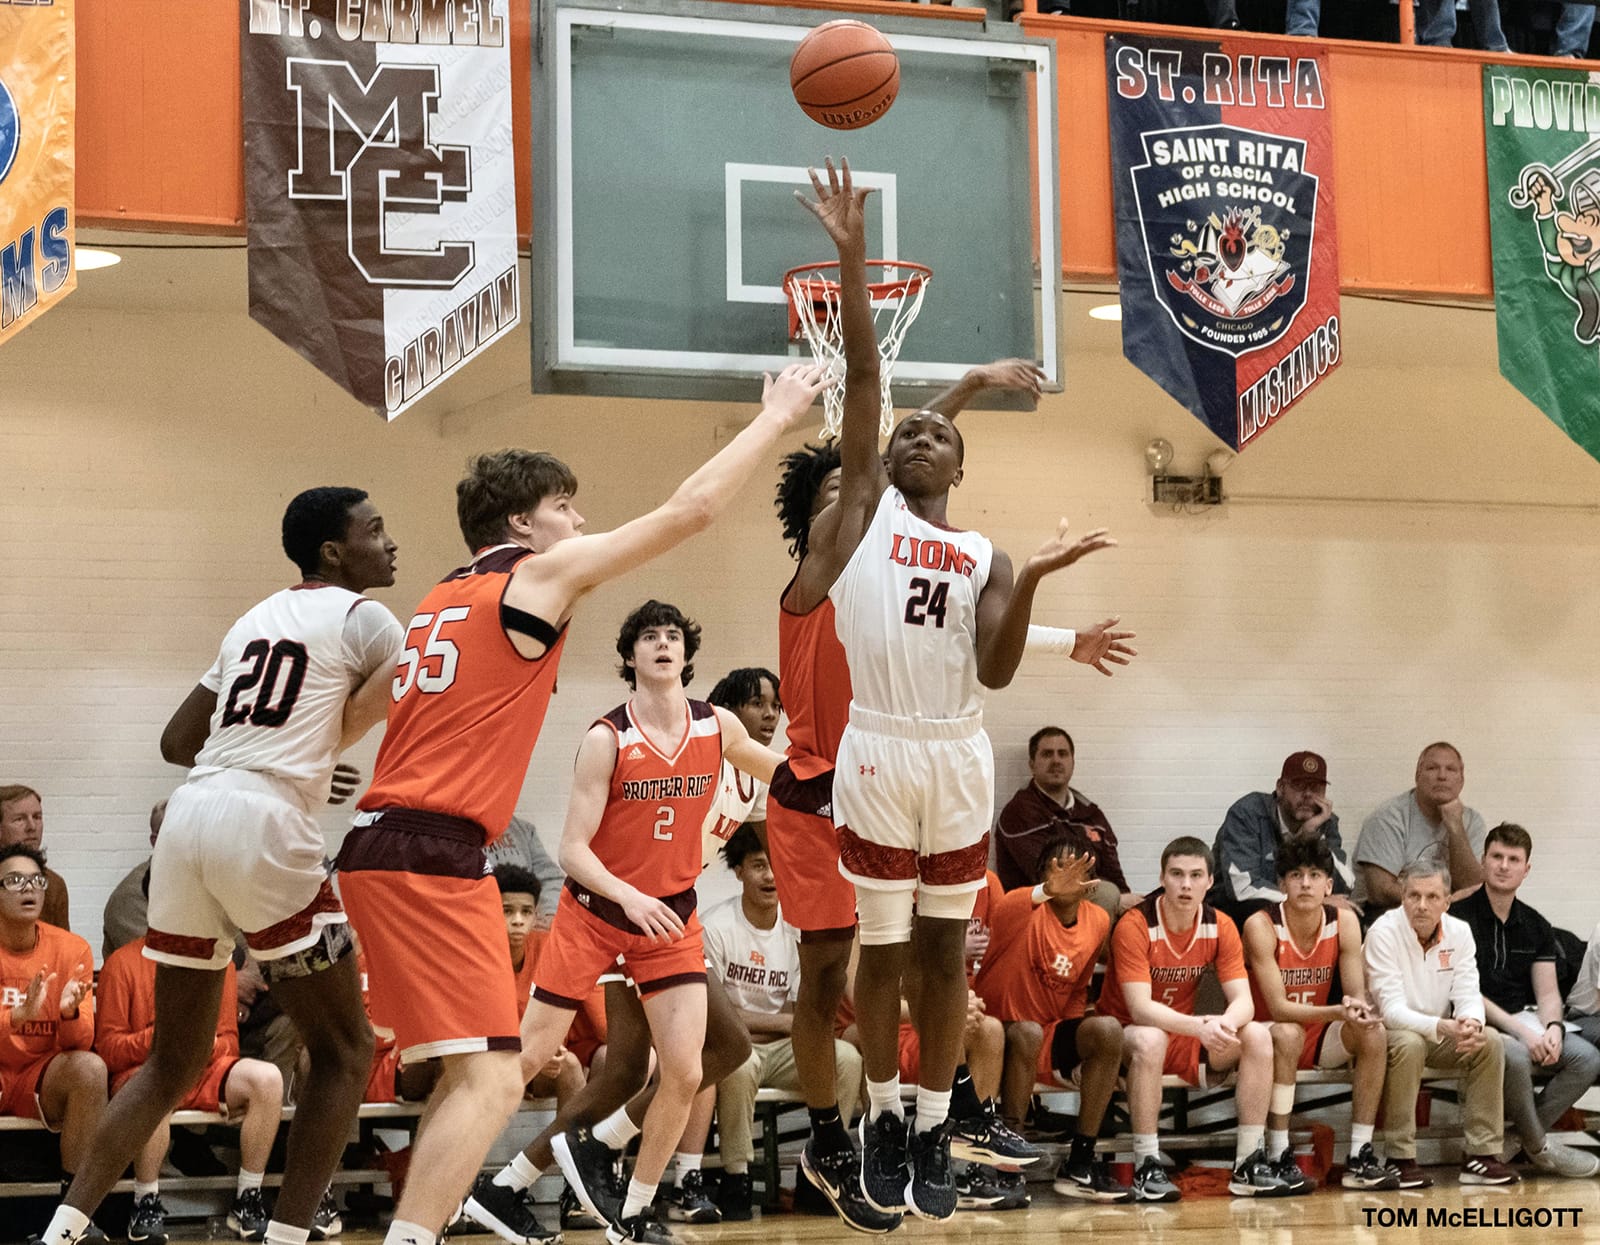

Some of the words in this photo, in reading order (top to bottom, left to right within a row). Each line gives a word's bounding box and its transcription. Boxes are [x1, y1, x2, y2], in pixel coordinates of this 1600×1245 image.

[335, 0, 504, 47] CARMEL
[821, 94, 892, 125] Wilson
[1152, 138, 1230, 166] SAINT
[1238, 140, 1300, 173] RITA
[1182, 165, 1204, 179] OF
[1209, 165, 1274, 185] CASCIA
[1157, 182, 1211, 208] HIGH
[1216, 182, 1298, 215] SCHOOL
[384, 264, 518, 413] CARAVAN
[1201, 325, 1245, 343] FOUNDED
[1248, 327, 1269, 342] 1905
[1216, 321, 1254, 331] CHICAGO
[1239, 315, 1341, 444] MUSTANGS
[904, 577, 950, 629] 24
[392, 605, 472, 703] 55
[220, 638, 309, 729] 20
[652, 804, 676, 841] 2
[1161, 987, 1179, 1007] 5
